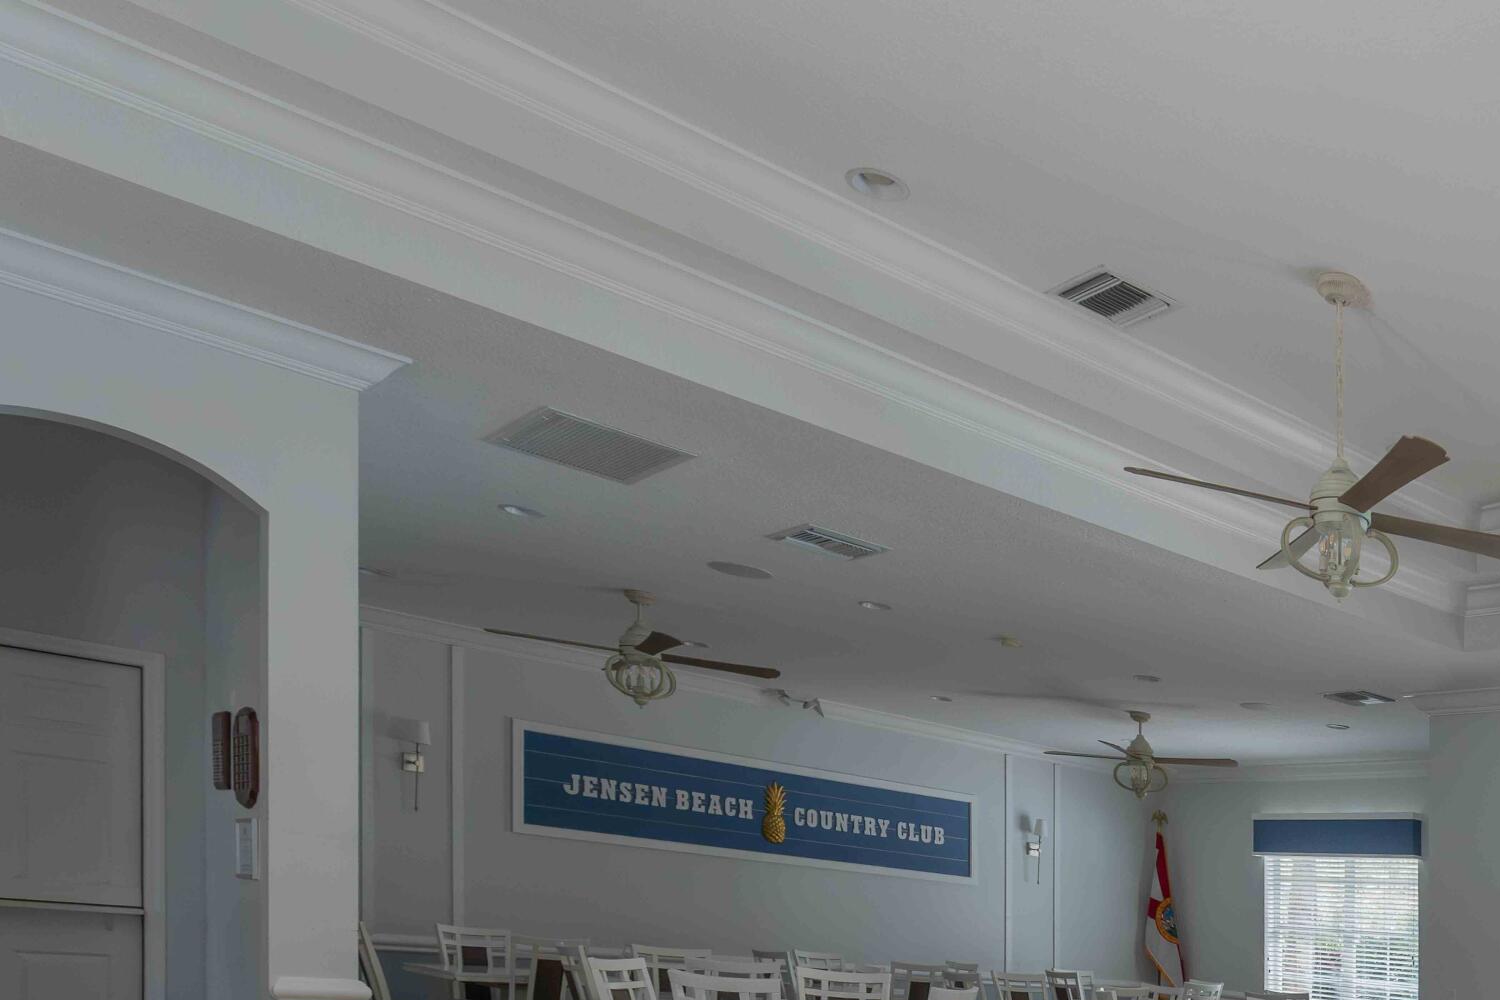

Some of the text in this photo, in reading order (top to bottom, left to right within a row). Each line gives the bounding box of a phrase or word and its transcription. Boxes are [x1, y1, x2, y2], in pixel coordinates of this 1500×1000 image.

[563, 774, 946, 845] JENSEN BEACH COUNTRY CLUB
